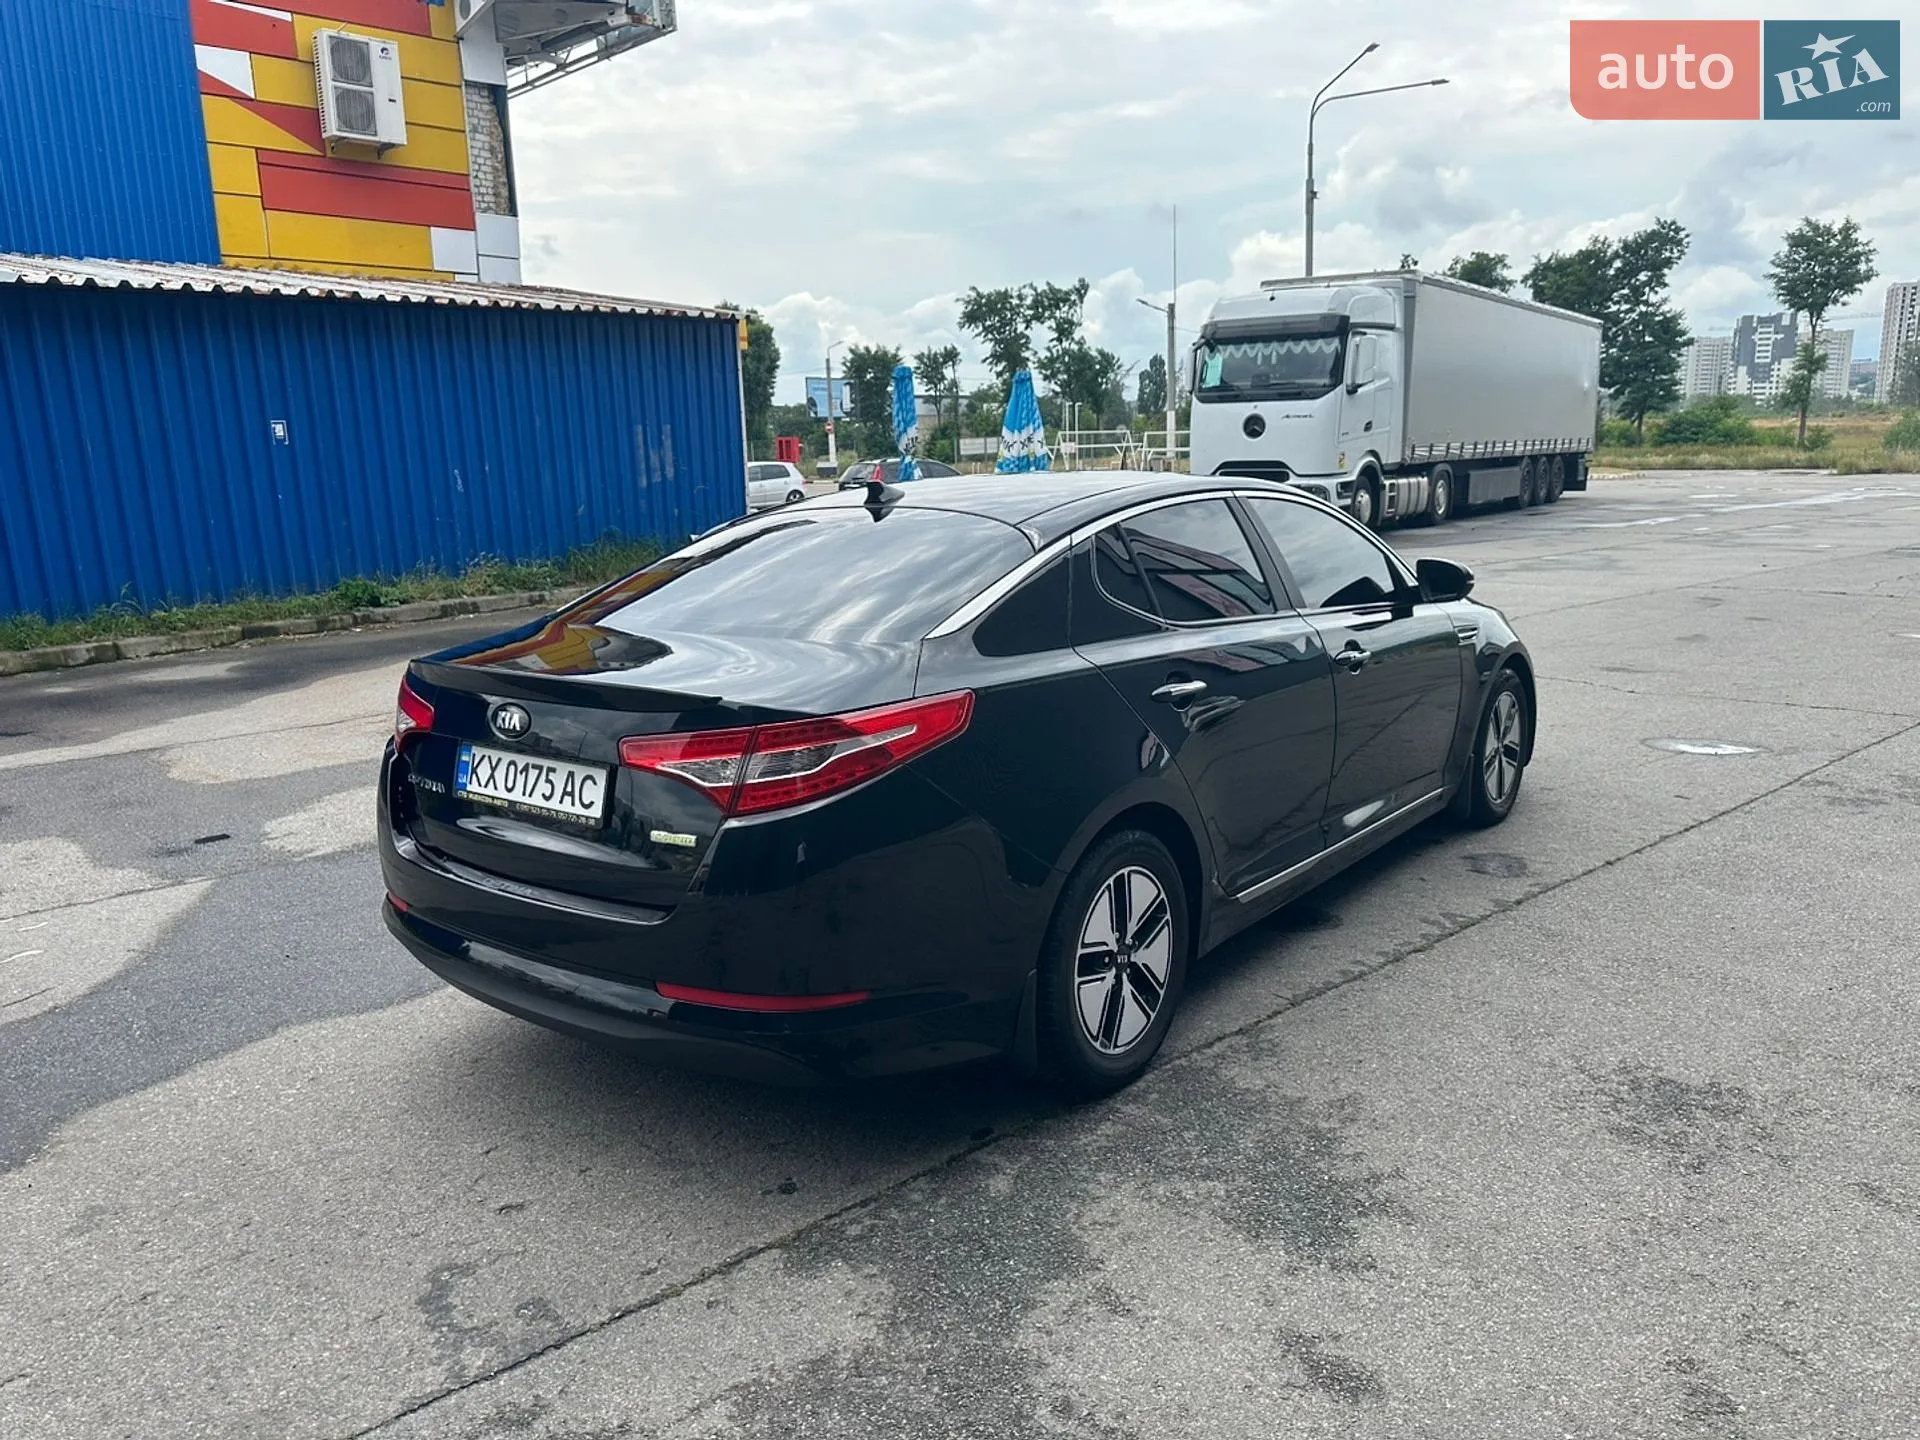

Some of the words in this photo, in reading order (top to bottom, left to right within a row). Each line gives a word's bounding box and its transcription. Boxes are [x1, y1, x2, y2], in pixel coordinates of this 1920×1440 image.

[496, 710, 521, 731] KIA
[469, 752, 504, 791] KX
[504, 758, 558, 803] 0175
[559, 770, 598, 810] AC
